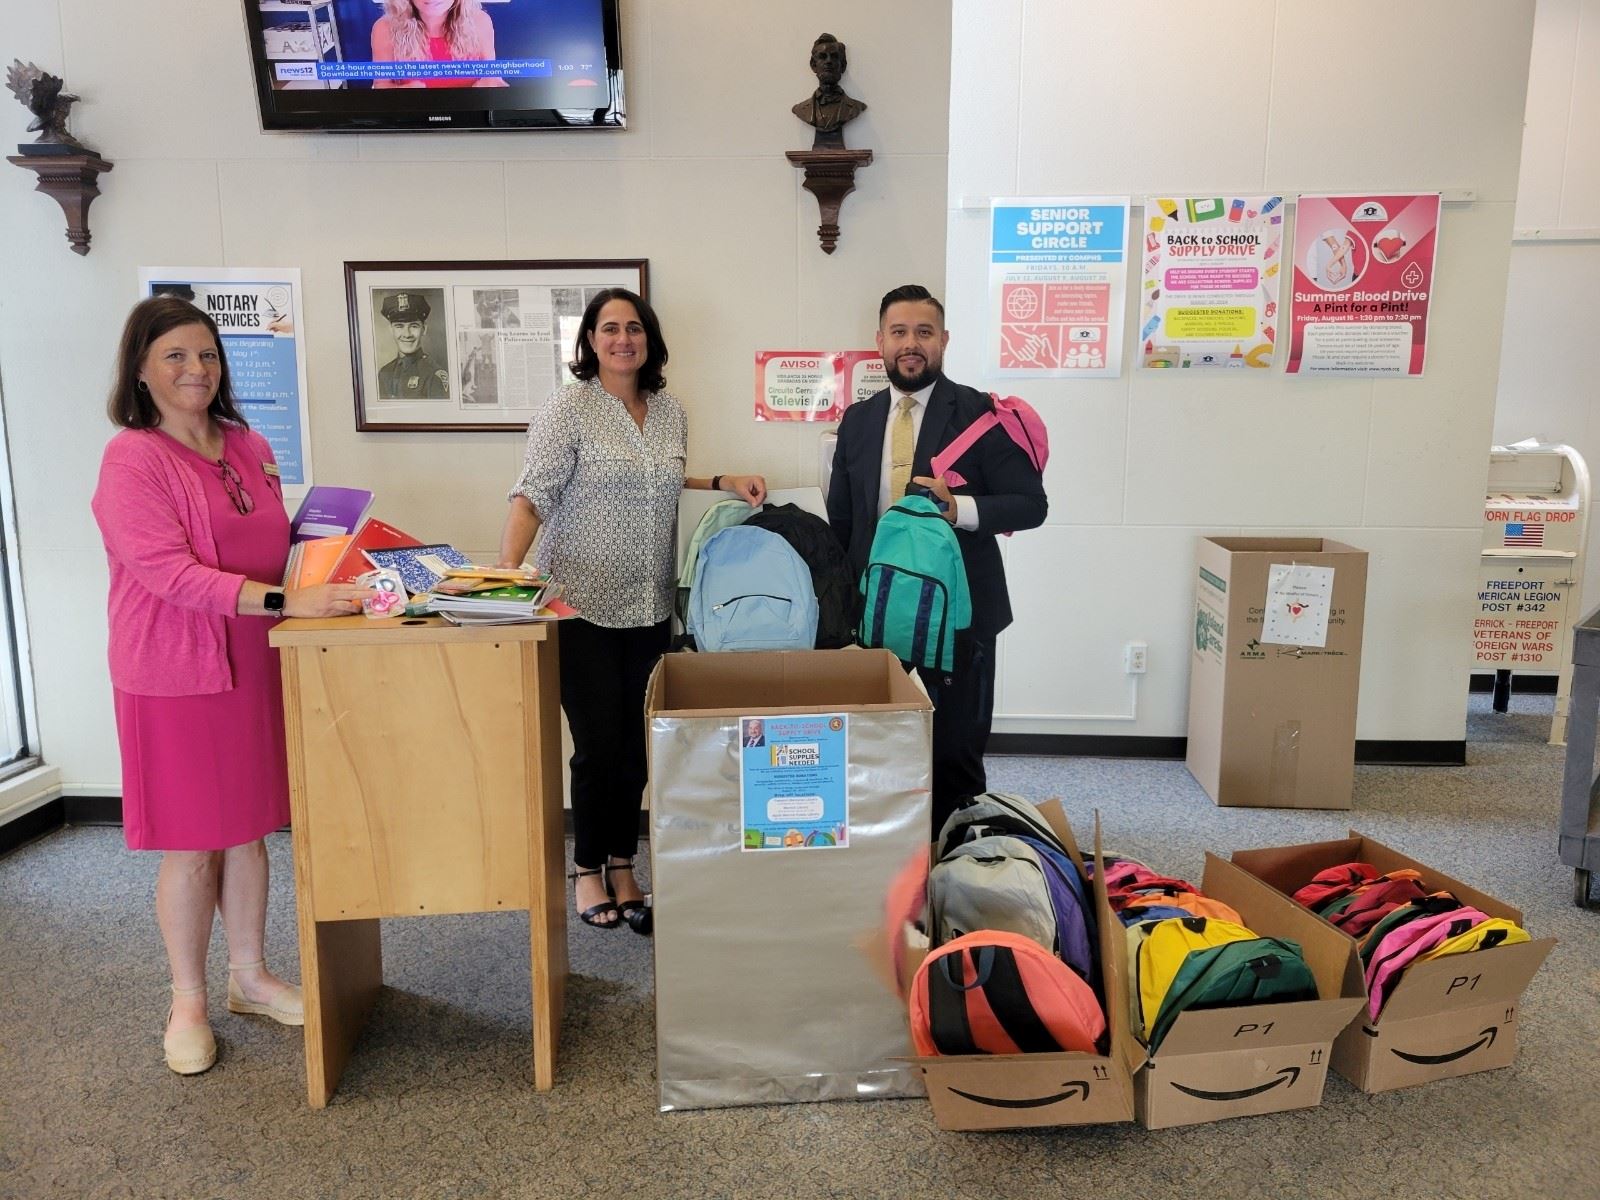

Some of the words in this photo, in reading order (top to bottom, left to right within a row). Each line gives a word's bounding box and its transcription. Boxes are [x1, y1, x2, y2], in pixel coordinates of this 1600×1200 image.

[418, 62, 440, 70] latest
[471, 62, 489, 71] your
[490, 61, 545, 70] neighborhood
[407, 70, 421, 78] app
[454, 68, 502, 76] News12.com
[1031, 208, 1090, 221] SENIOR
[1016, 221, 1104, 236] SUPPORT
[1031, 236, 1088, 249] CIRCLE
[1167, 235, 1199, 246] BACK
[1201, 236, 1213, 245] to
[1215, 234, 1261, 246] SCHOOL
[1169, 245, 1216, 257] SUPPLY
[1218, 244, 1256, 256] DRIVE
[1295, 291, 1351, 302] Summer
[1353, 291, 1390, 302] Blood
[1392, 290, 1427, 301] Drive
[207, 294, 258, 312] NOTARY
[1313, 304, 1322, 312] A
[1324, 303, 1348, 312] Pint
[1350, 303, 1367, 312] for
[1380, 302, 1409, 312] Pint!
[208, 312, 260, 327] SERVICES
[1296, 315, 1321, 323] Friday,
[1321, 314, 1346, 323] August
[780, 361, 820, 369] AVISO!
[768, 386, 794, 394] Circuito
[1484, 511, 1510, 522] ORN
[1513, 511, 1541, 522] FLAG
[1545, 511, 1576, 523] DROP
[1486, 580, 1545, 590] FREEPORT
[1477, 592, 1520, 601] MERICAN
[1524, 592, 1561, 601] LEGION
[1338, 607, 1345, 615] in
[1481, 603, 1512, 612] POST
[1516, 603, 1545, 612] #342
[1474, 619, 1505, 628] ERRICK
[1515, 620, 1559, 630] FREEPORT
[1473, 630, 1532, 640] VETERANS
[1536, 632, 1552, 641] OF
[1473, 641, 1517, 650] OREIGN
[1522, 642, 1553, 651] WARS
[1476, 652, 1506, 661] POST
[1511, 653, 1543, 662] #1310
[1446, 974, 1482, 995] P1
[1234, 1021, 1274, 1038] P1
